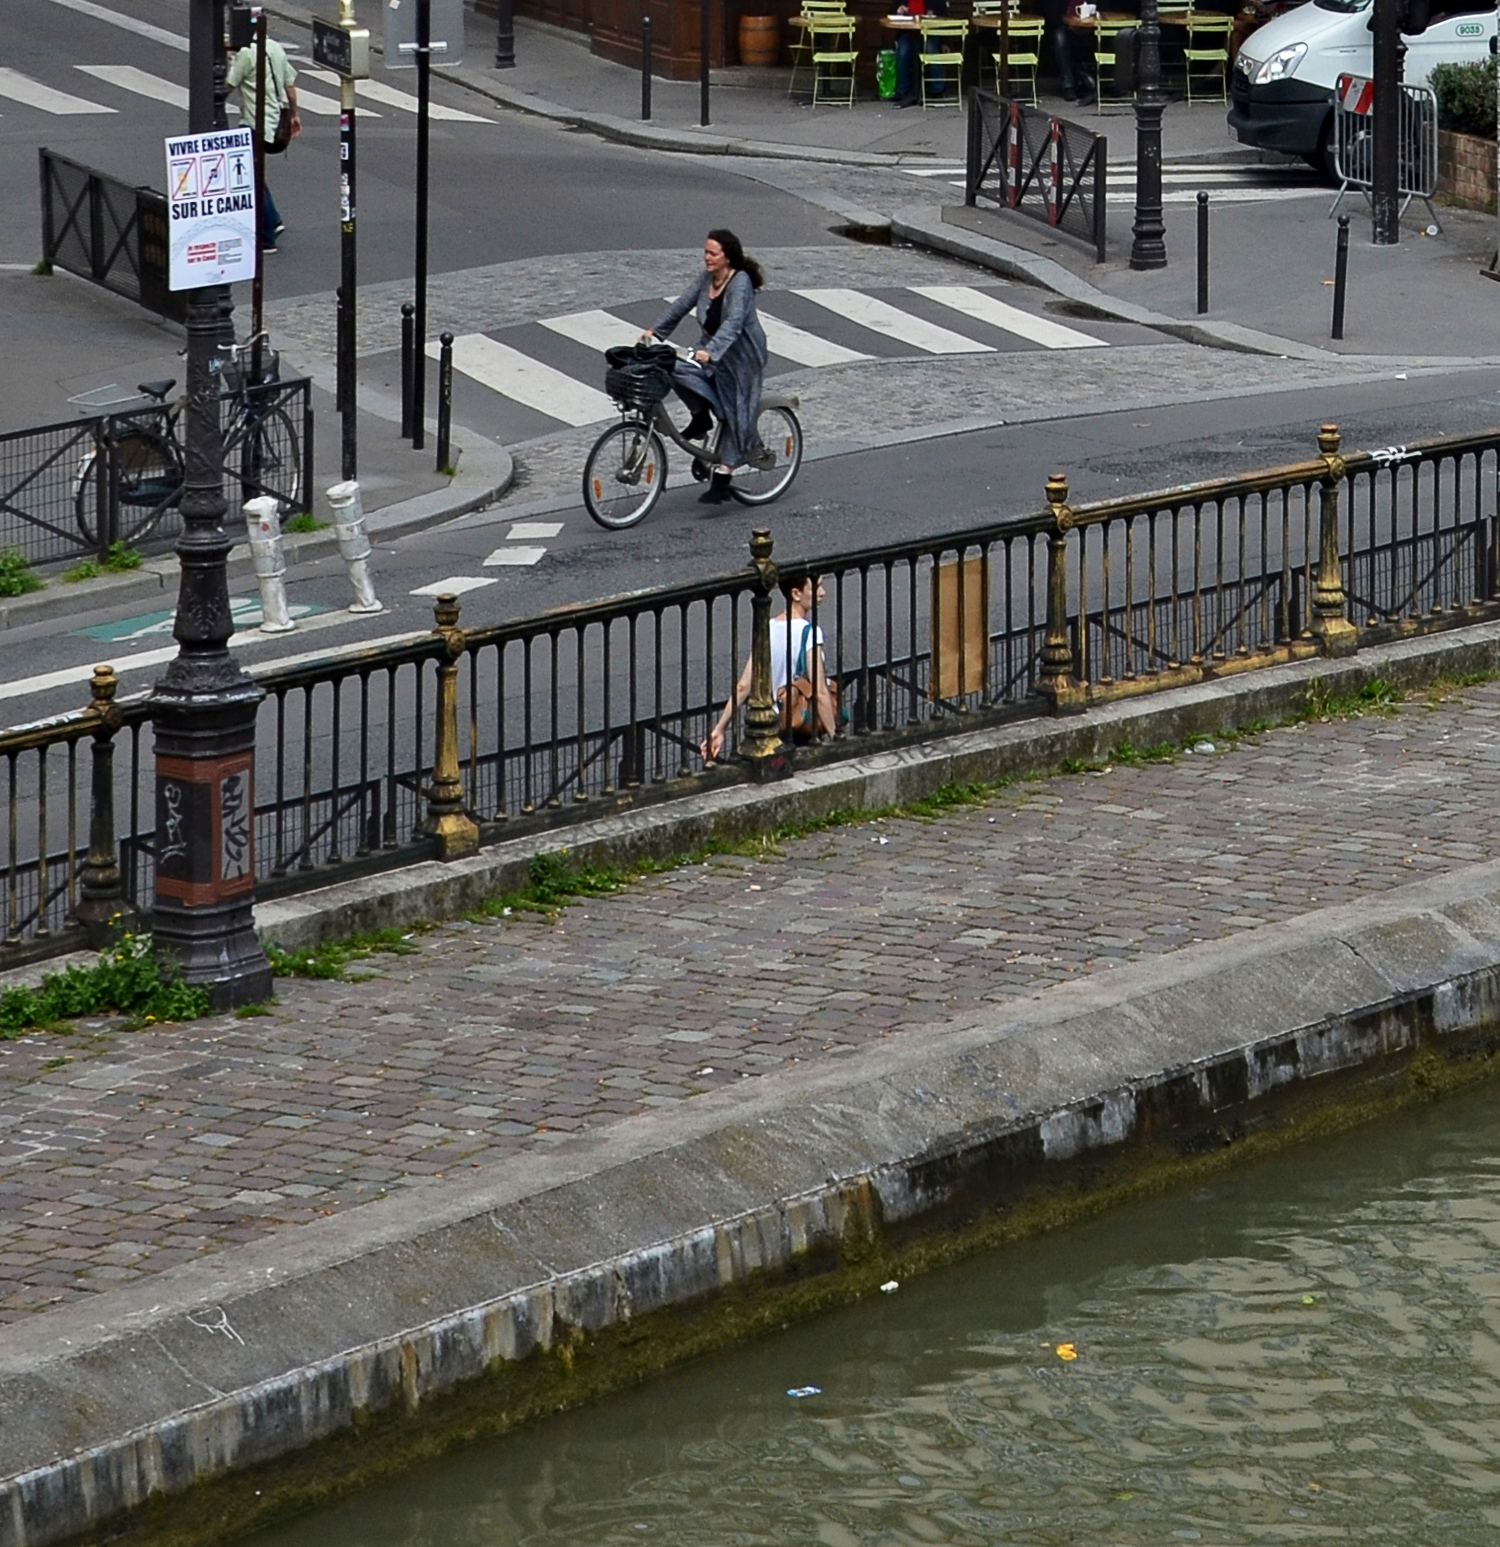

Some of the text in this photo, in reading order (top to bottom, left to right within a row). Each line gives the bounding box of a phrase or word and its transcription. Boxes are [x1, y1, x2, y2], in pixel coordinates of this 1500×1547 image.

[168, 132, 251, 157] VIVRE ENSEMBLE
[172, 193, 254, 220] SUR LE CANAL
